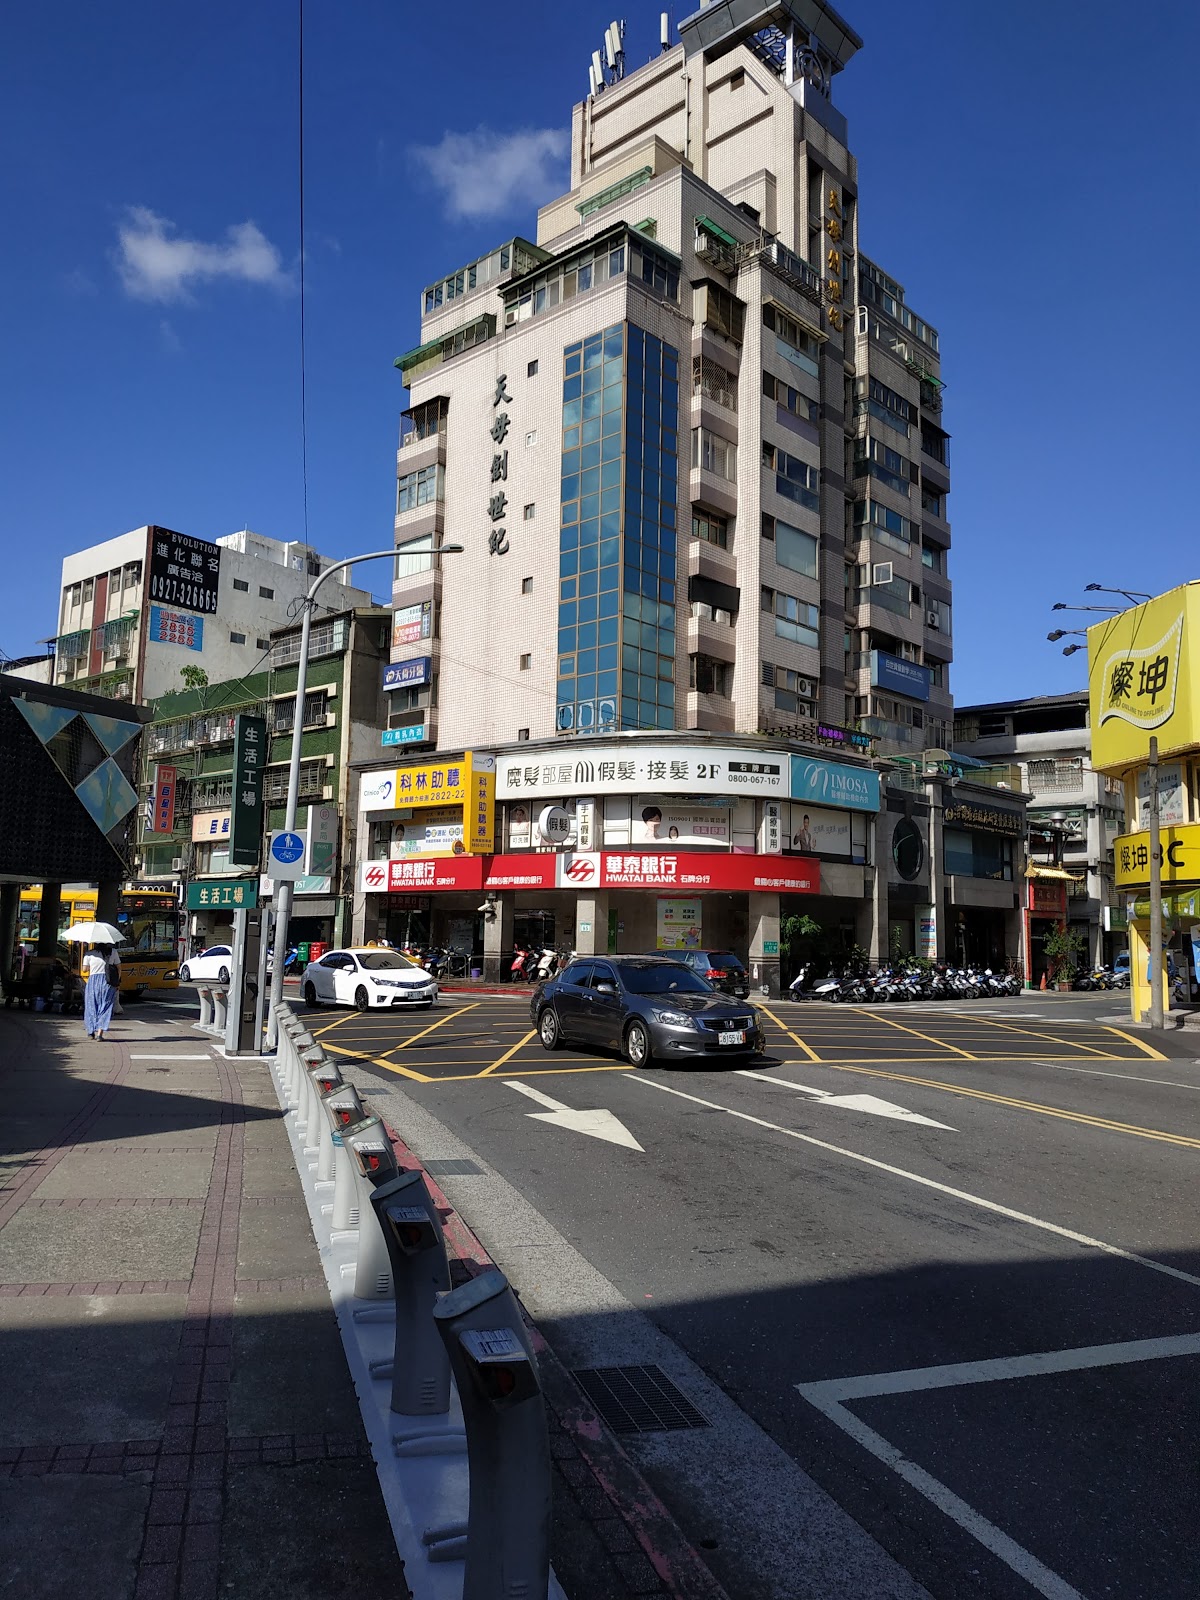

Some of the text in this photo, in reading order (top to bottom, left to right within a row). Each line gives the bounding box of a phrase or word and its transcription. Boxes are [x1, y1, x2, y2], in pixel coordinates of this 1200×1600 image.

[827, 190, 842, 332] 天母創世紀
[487, 373, 513, 556] 天母創世紀
[172, 534, 218, 555] EVOLUTION
[157, 542, 219, 572] 進化聯名
[167, 564, 203, 584] 廣告洽
[152, 575, 217, 610] 0927-326665
[160, 620, 195, 636] 2835
[1108, 655, 1168, 705] 燦坤
[1122, 702, 1137, 715] ONLINE
[1137, 709, 1143, 717] TO
[1143, 704, 1165, 717] OFFLINE
[242, 727, 259, 807] 生活工場
[697, 764, 721, 779] 2F
[740, 763, 771, 774] 石牌店
[399, 767, 464, 792] 科林助聽
[728, 775, 781, 785] 0800-067-167
[478, 776, 487, 837] 科林助聽器
[549, 818, 568, 832] 假髮
[580, 804, 589, 845] 手工假髮
[769, 806, 778, 849] 醫療專用
[606, 856, 678, 874] 華泰銀行
[1120, 843, 1148, 874] 燦坤
[391, 862, 435, 878] 華泰銀行
[605, 874, 710, 884] HWATAI BANK 石牌分行
[416, 878, 434, 886] BANK
[199, 887, 244, 904] 生活工場
